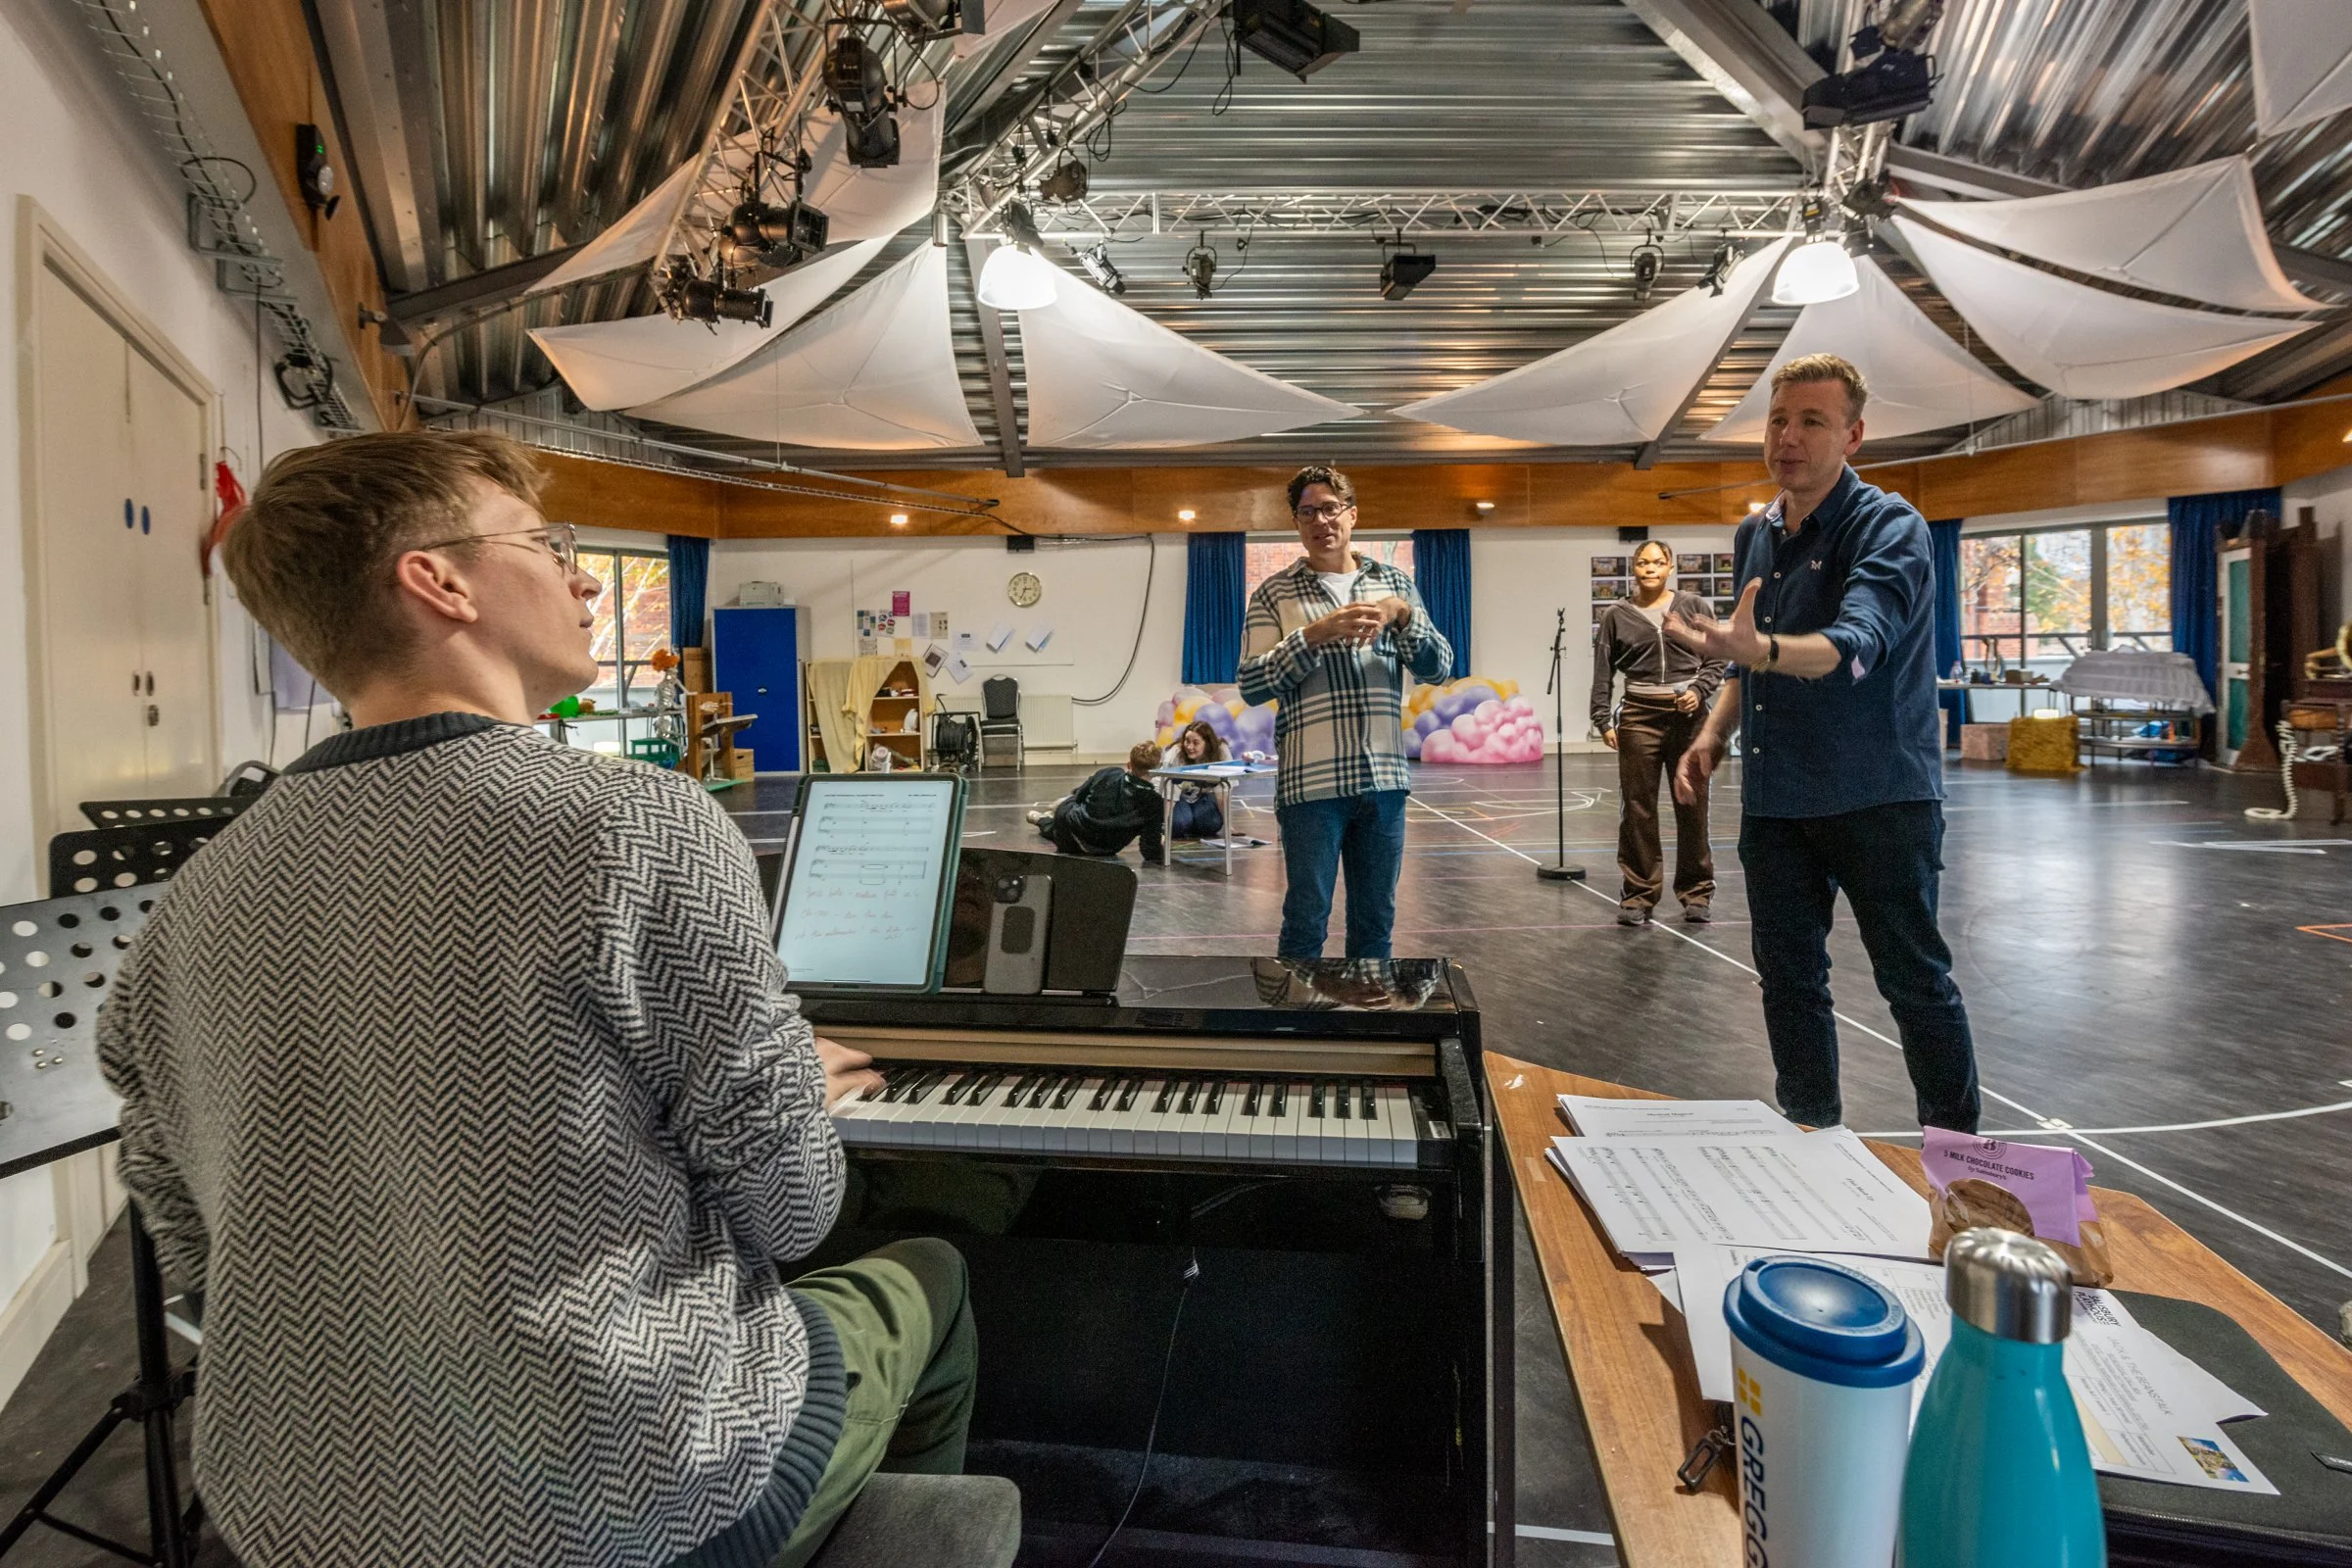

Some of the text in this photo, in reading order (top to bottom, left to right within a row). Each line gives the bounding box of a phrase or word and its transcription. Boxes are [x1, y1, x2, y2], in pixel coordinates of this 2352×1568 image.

[1949, 1151, 1965, 1162] MILK
[1966, 1155, 2004, 1173] CHOCOLATE
[2004, 1166, 2034, 1180] COOKIES
[2076, 1291, 2110, 1326] PLAYHOUSE
[2088, 1295, 2122, 1327] SALISBURY
[2134, 1373, 2175, 1416] BEANSTALK
[1741, 1416, 1768, 1568] GREGG
